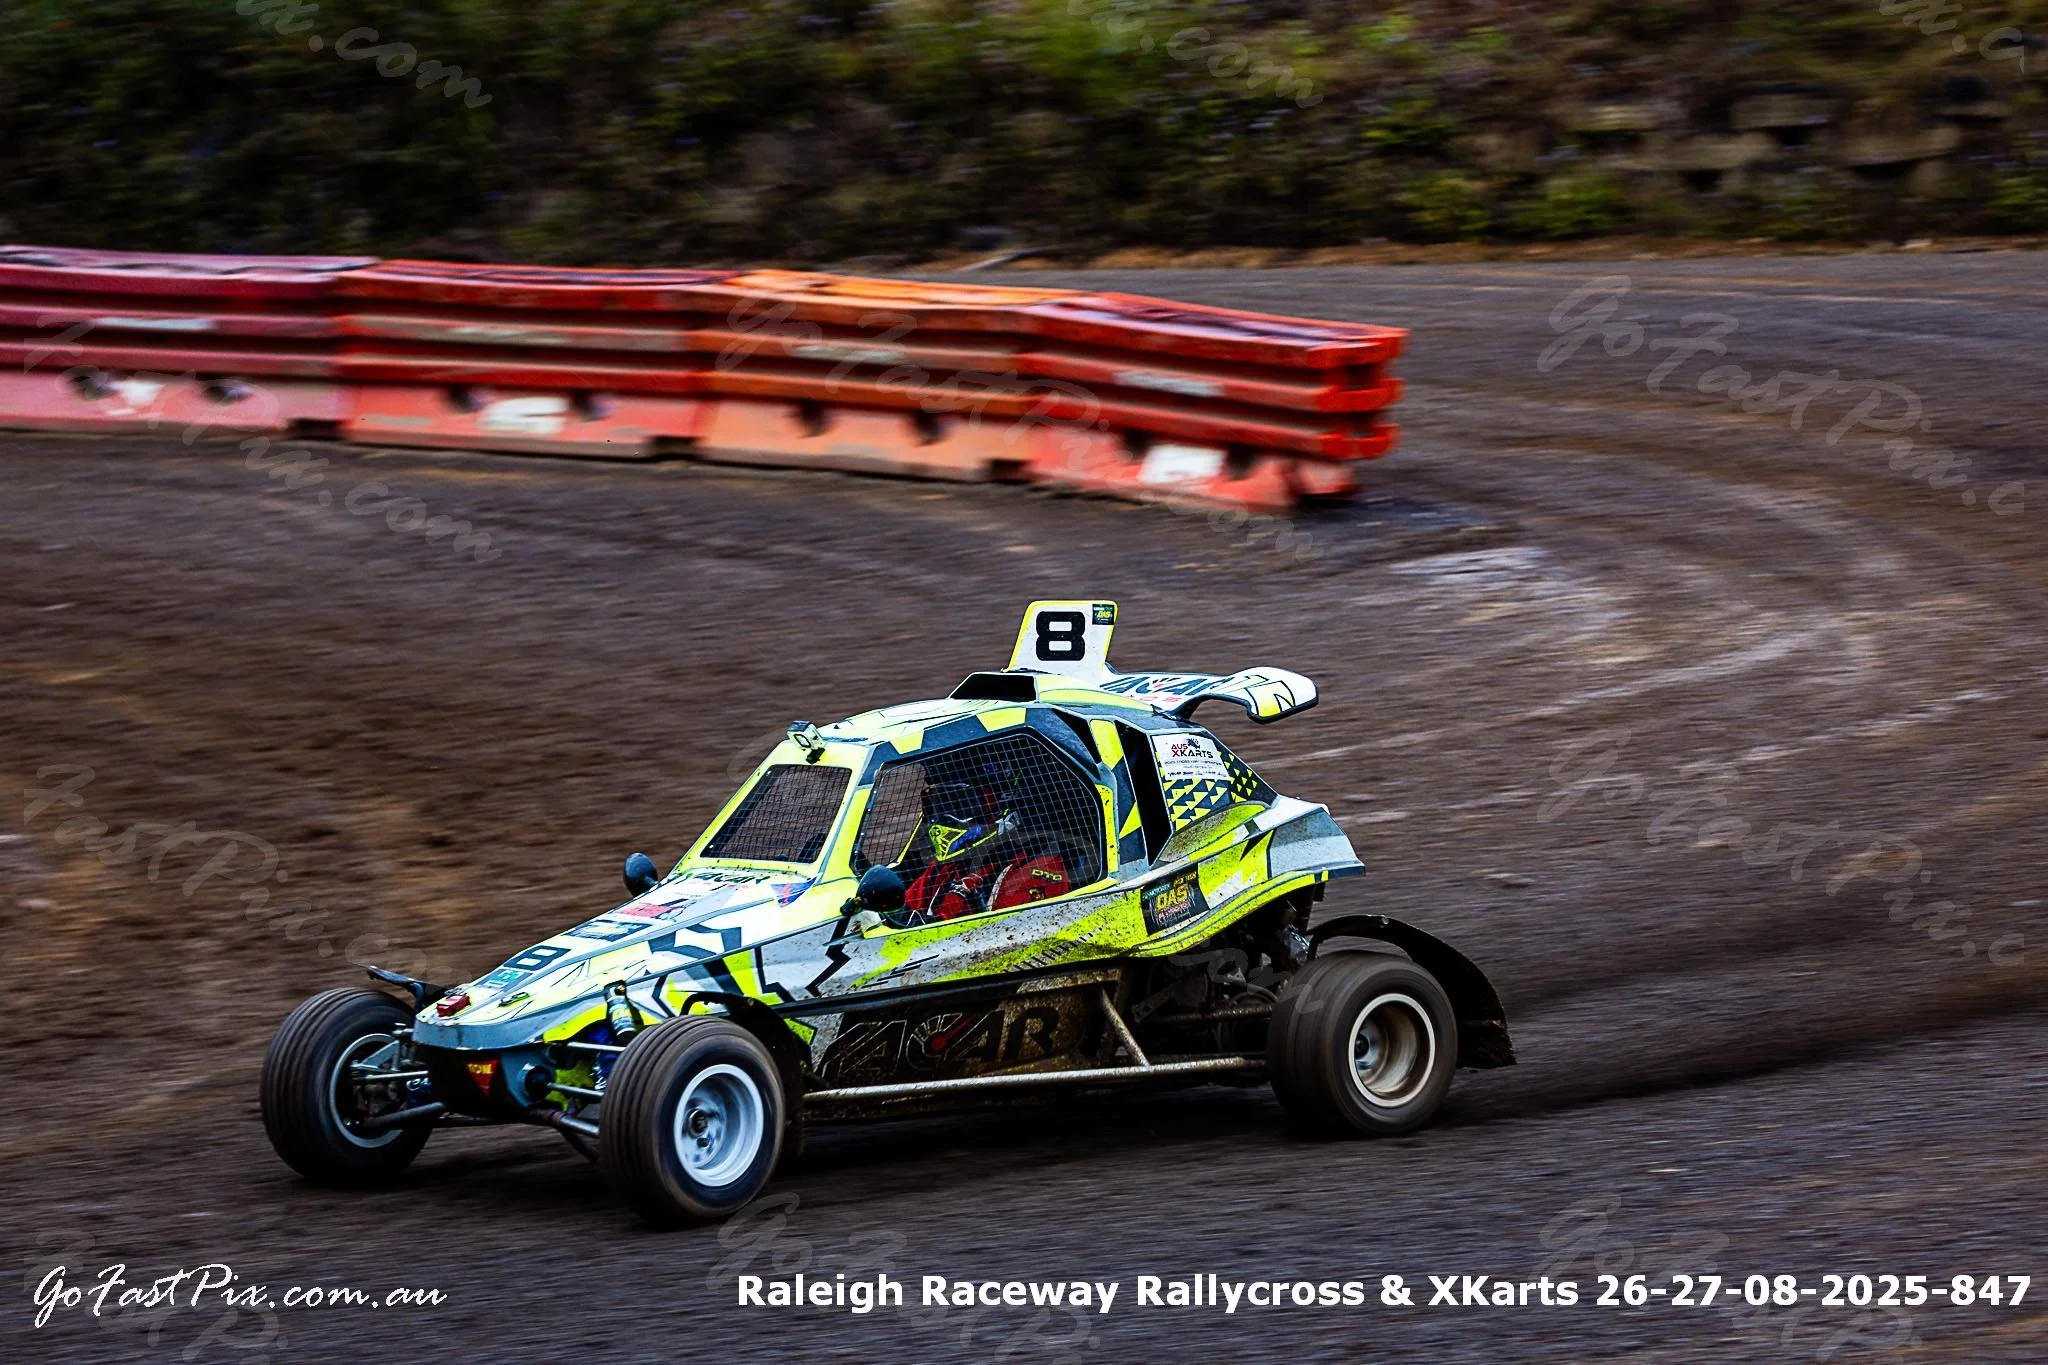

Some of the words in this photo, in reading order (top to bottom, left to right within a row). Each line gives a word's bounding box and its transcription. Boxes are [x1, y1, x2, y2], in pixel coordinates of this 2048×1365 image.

[1036, 611, 1086, 661] 8
[1171, 750, 1213, 759] XKARTS
[503, 945, 571, 971] 8
